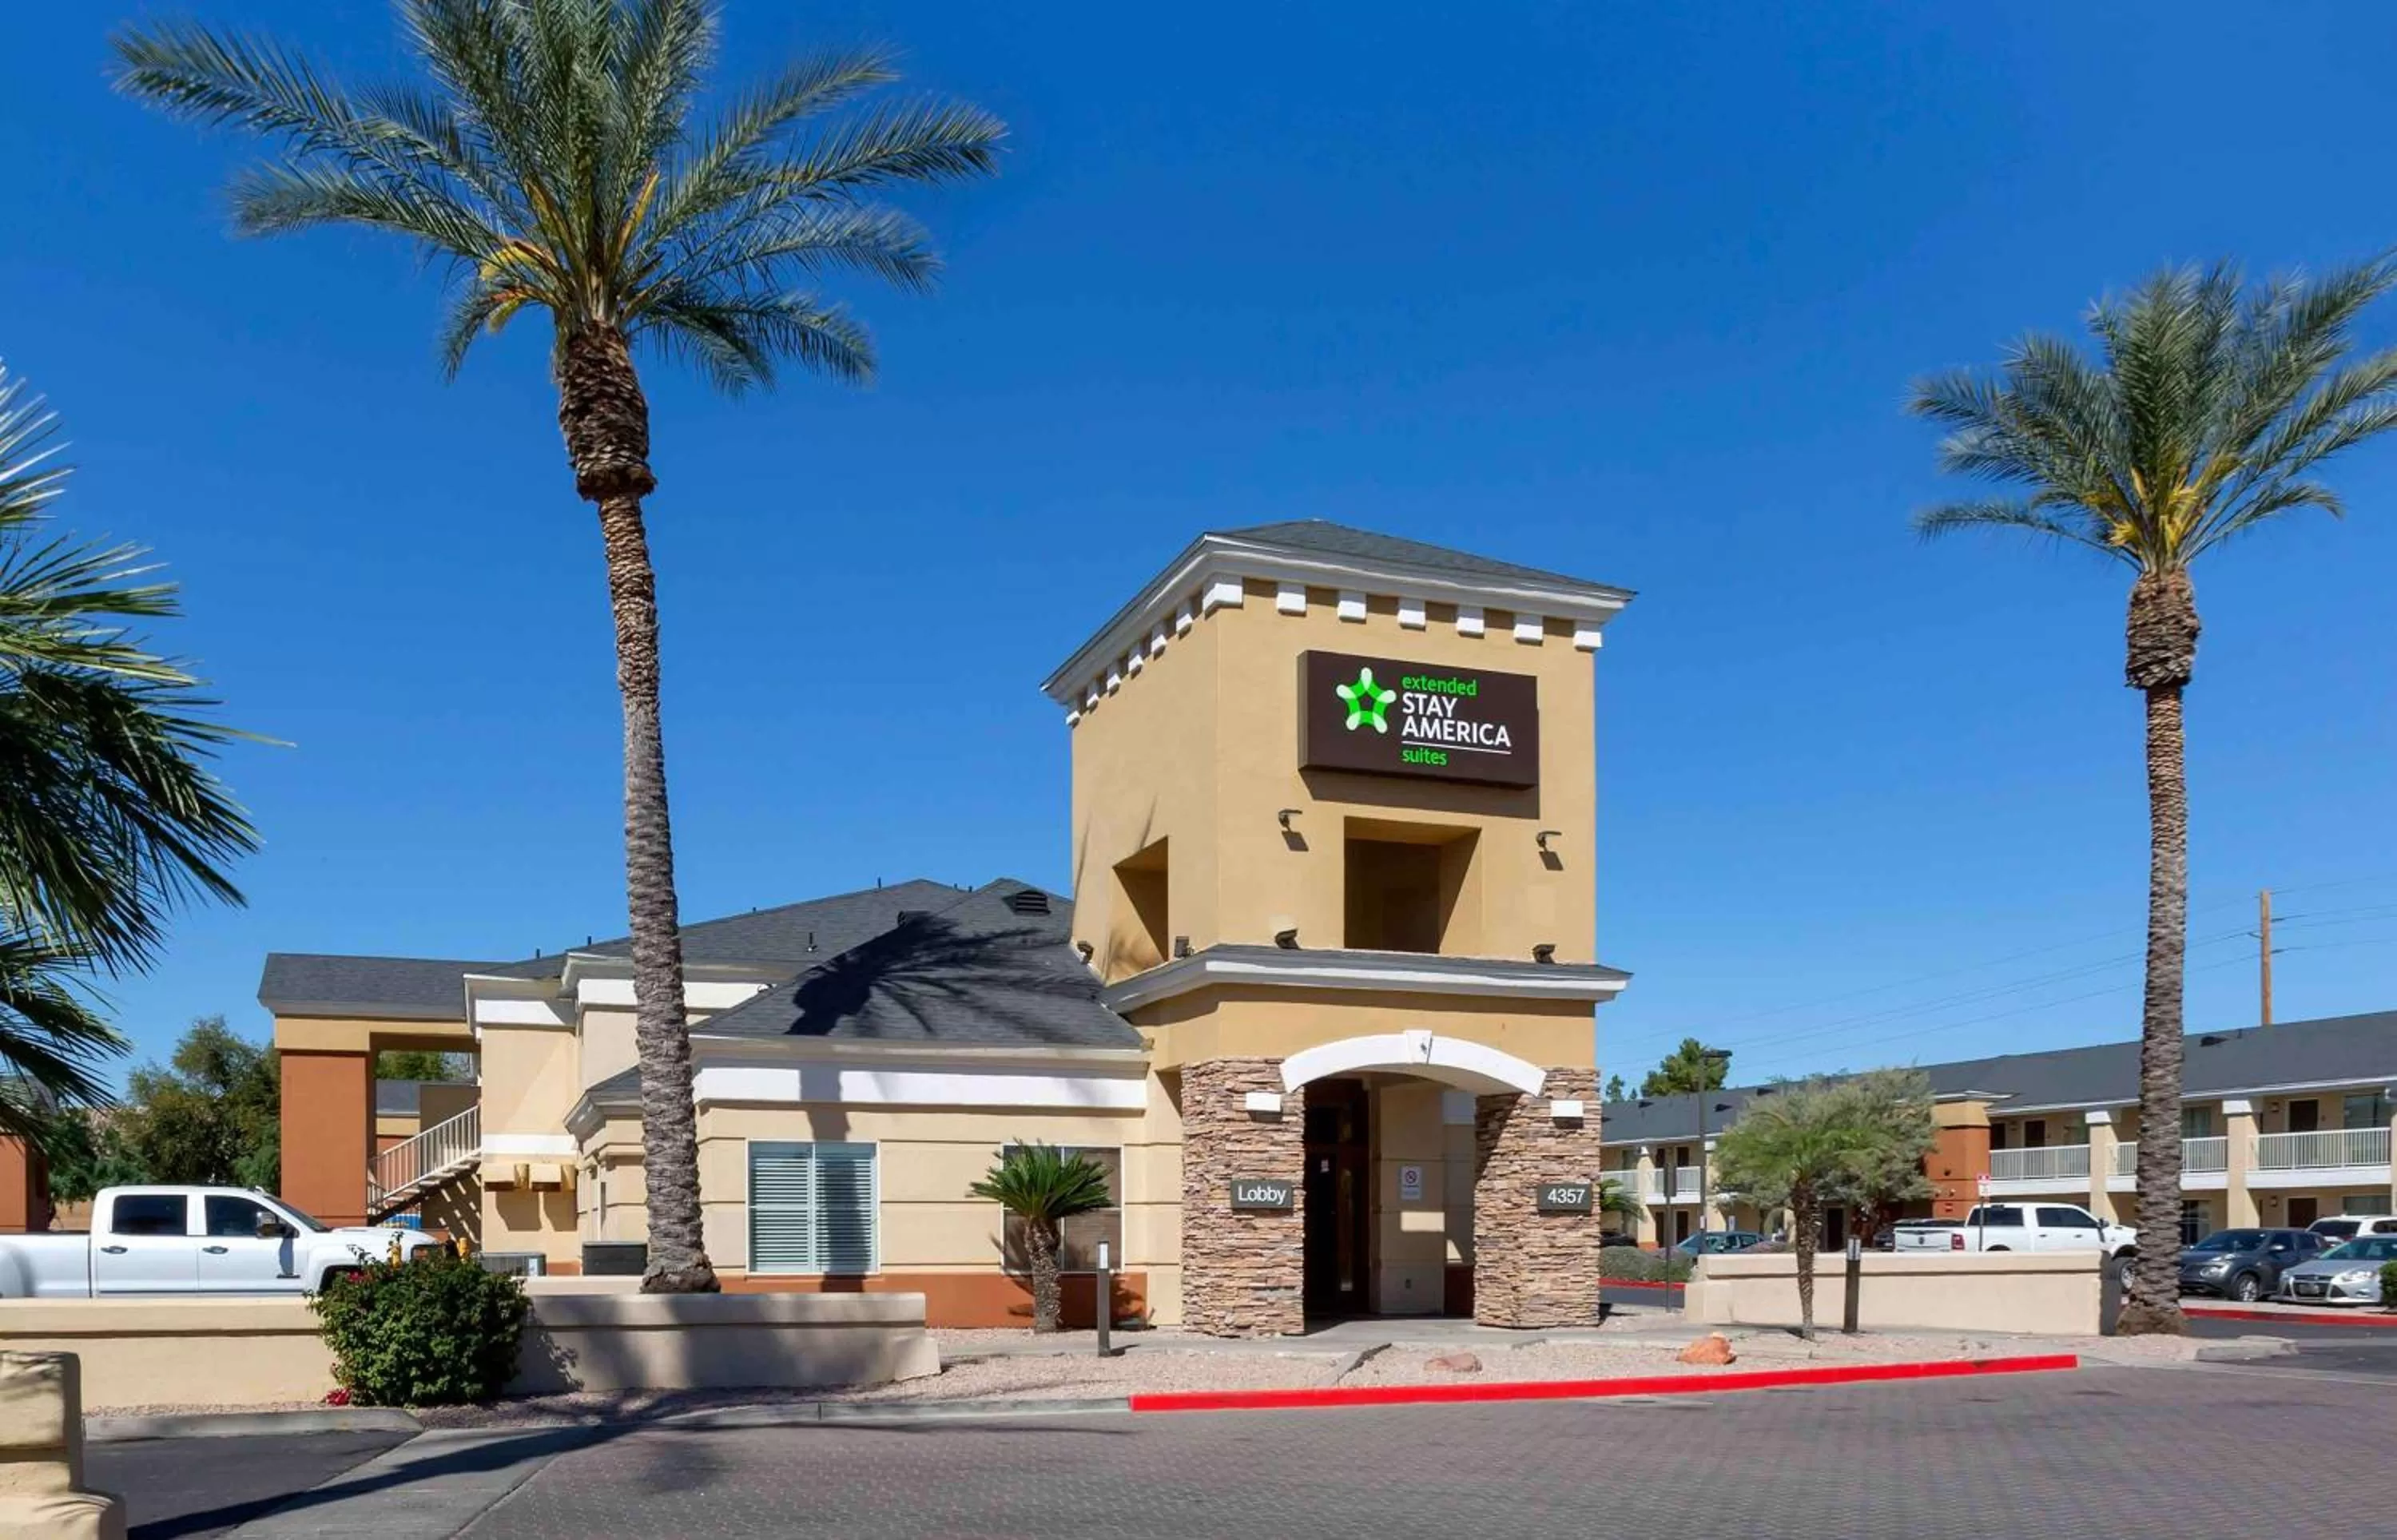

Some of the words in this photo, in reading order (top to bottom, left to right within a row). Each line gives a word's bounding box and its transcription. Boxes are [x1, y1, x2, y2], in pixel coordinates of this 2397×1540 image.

[1402, 675, 1477, 696] extended
[1402, 692, 1457, 718] STAY
[1401, 716, 1512, 747] AMERICA
[1402, 748, 1447, 765] suites
[1238, 1185, 1286, 1205] Lobby
[1548, 1188, 1585, 1204] 4357
